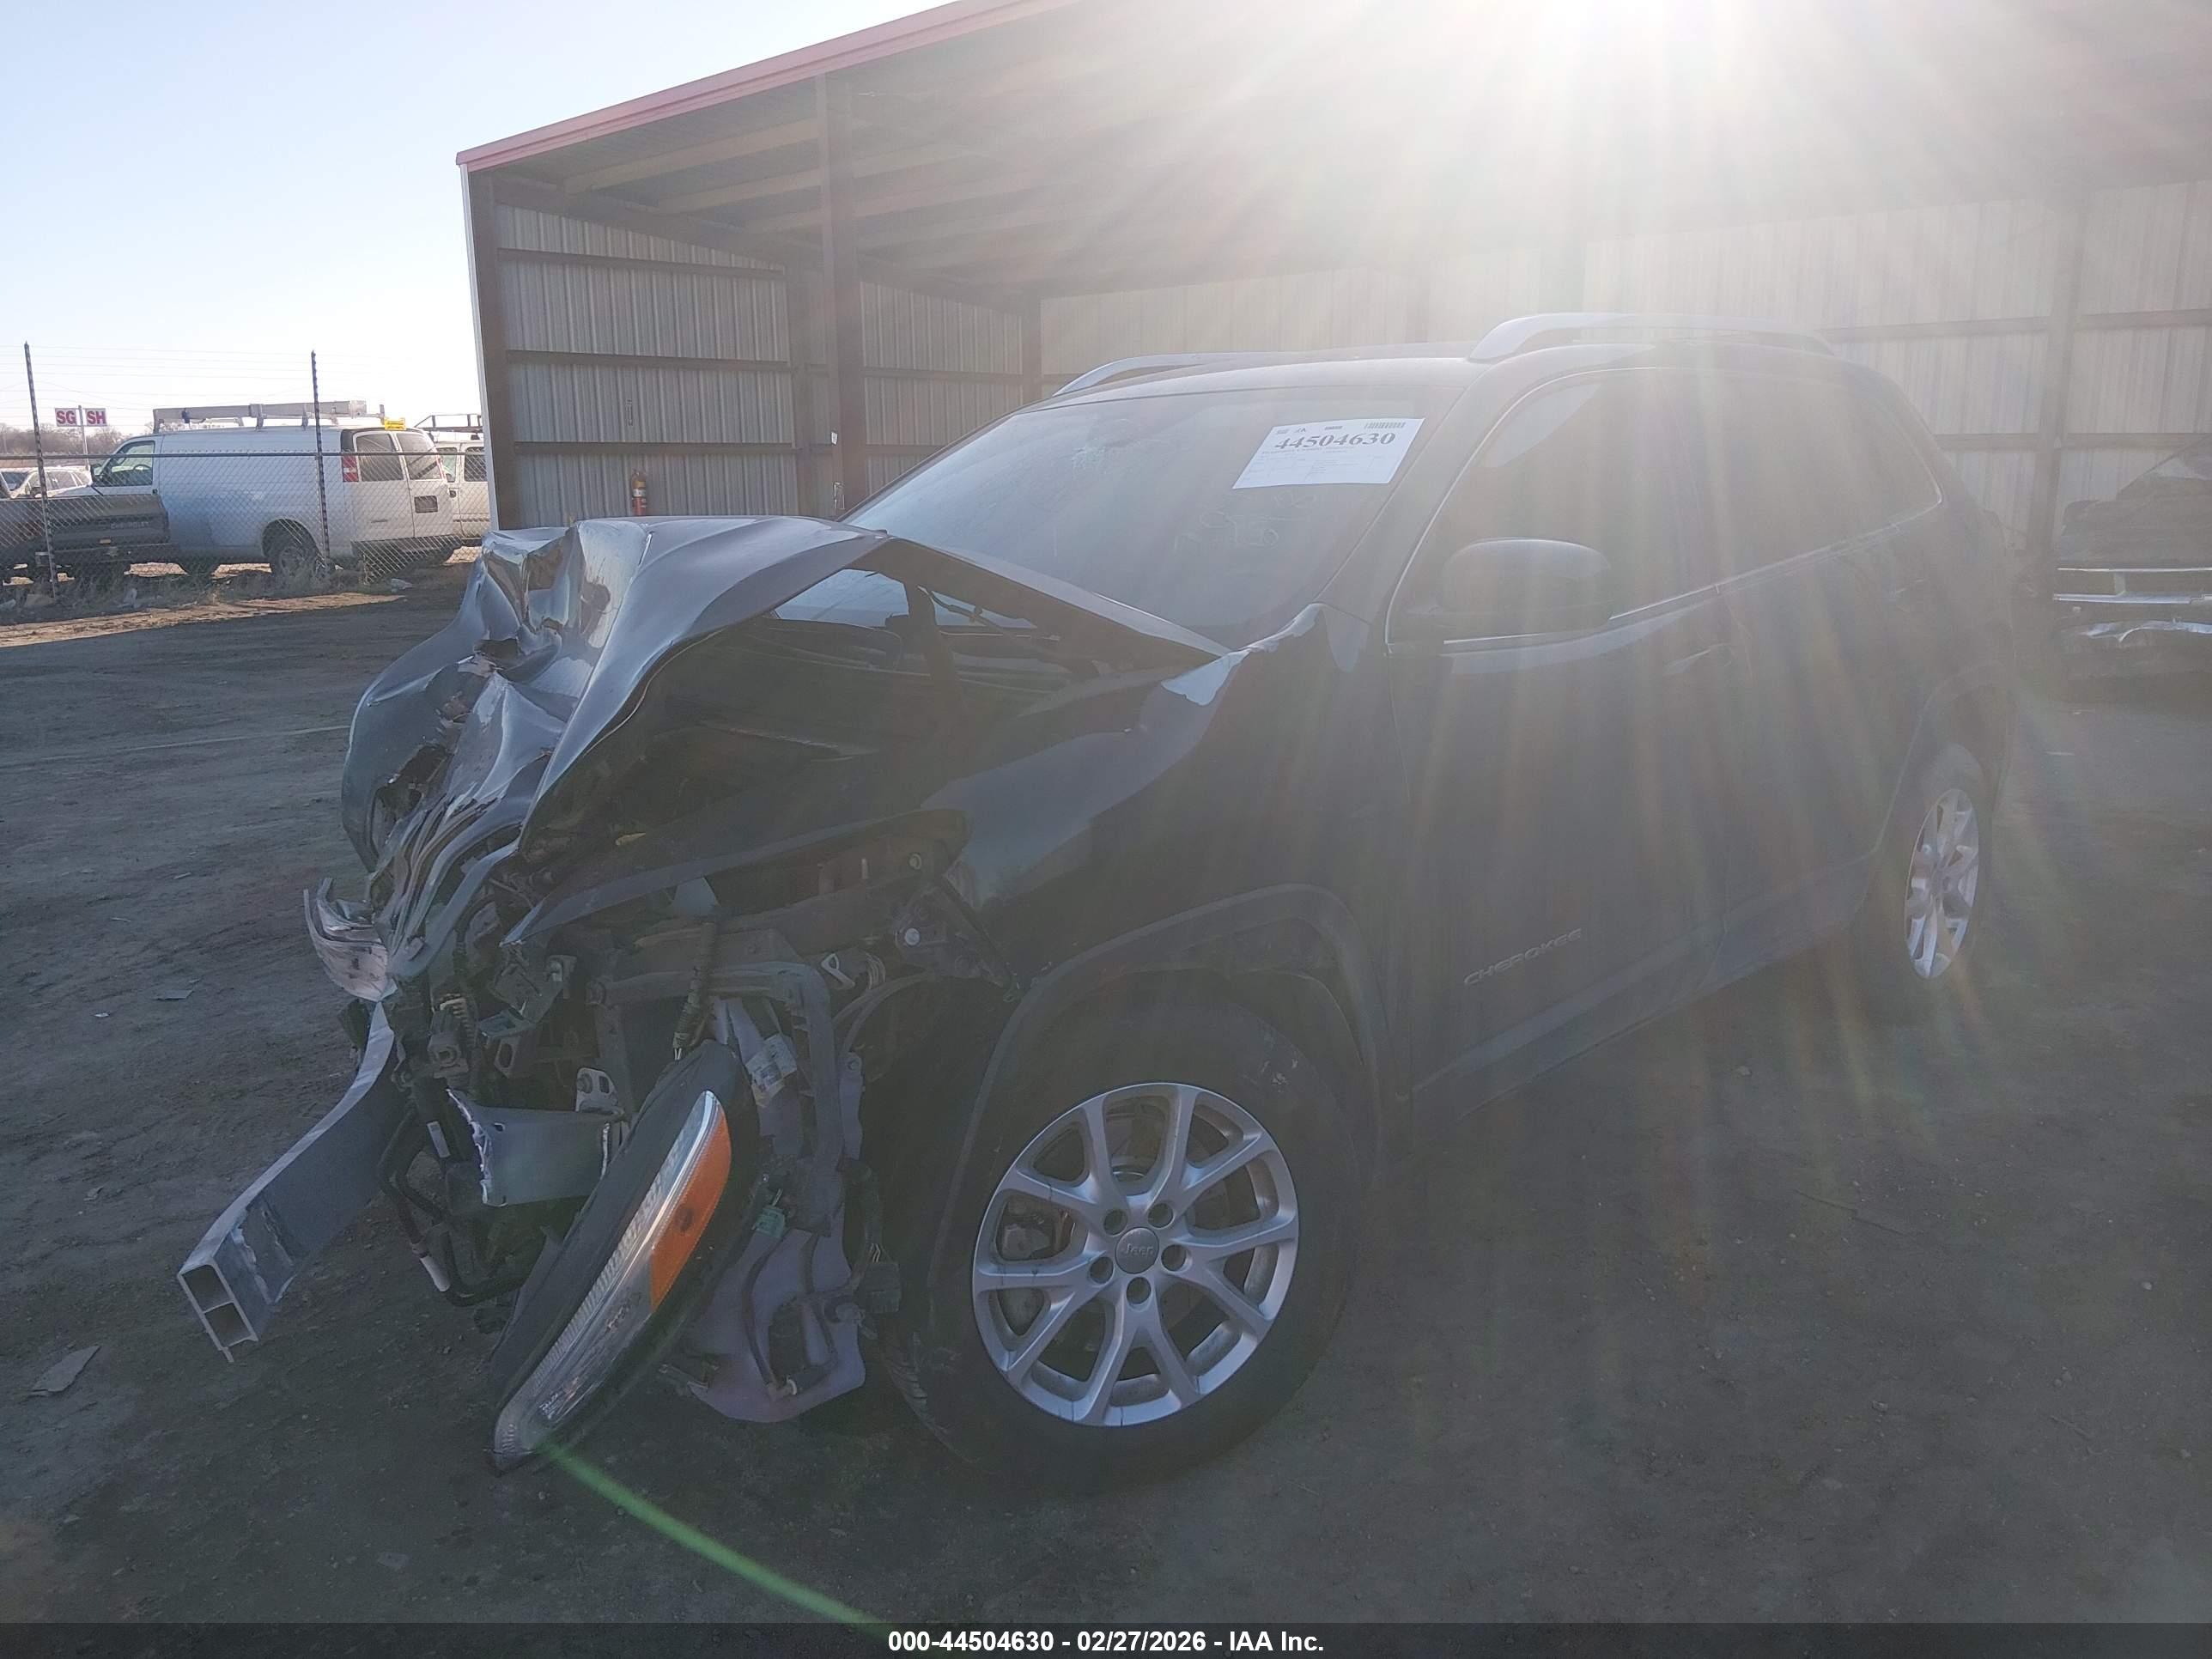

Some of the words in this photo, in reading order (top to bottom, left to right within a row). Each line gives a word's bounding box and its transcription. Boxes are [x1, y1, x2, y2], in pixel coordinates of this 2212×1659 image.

[56, 410, 76, 425] SG
[87, 410, 106, 425] SH
[1274, 431, 1396, 450] 44504630
